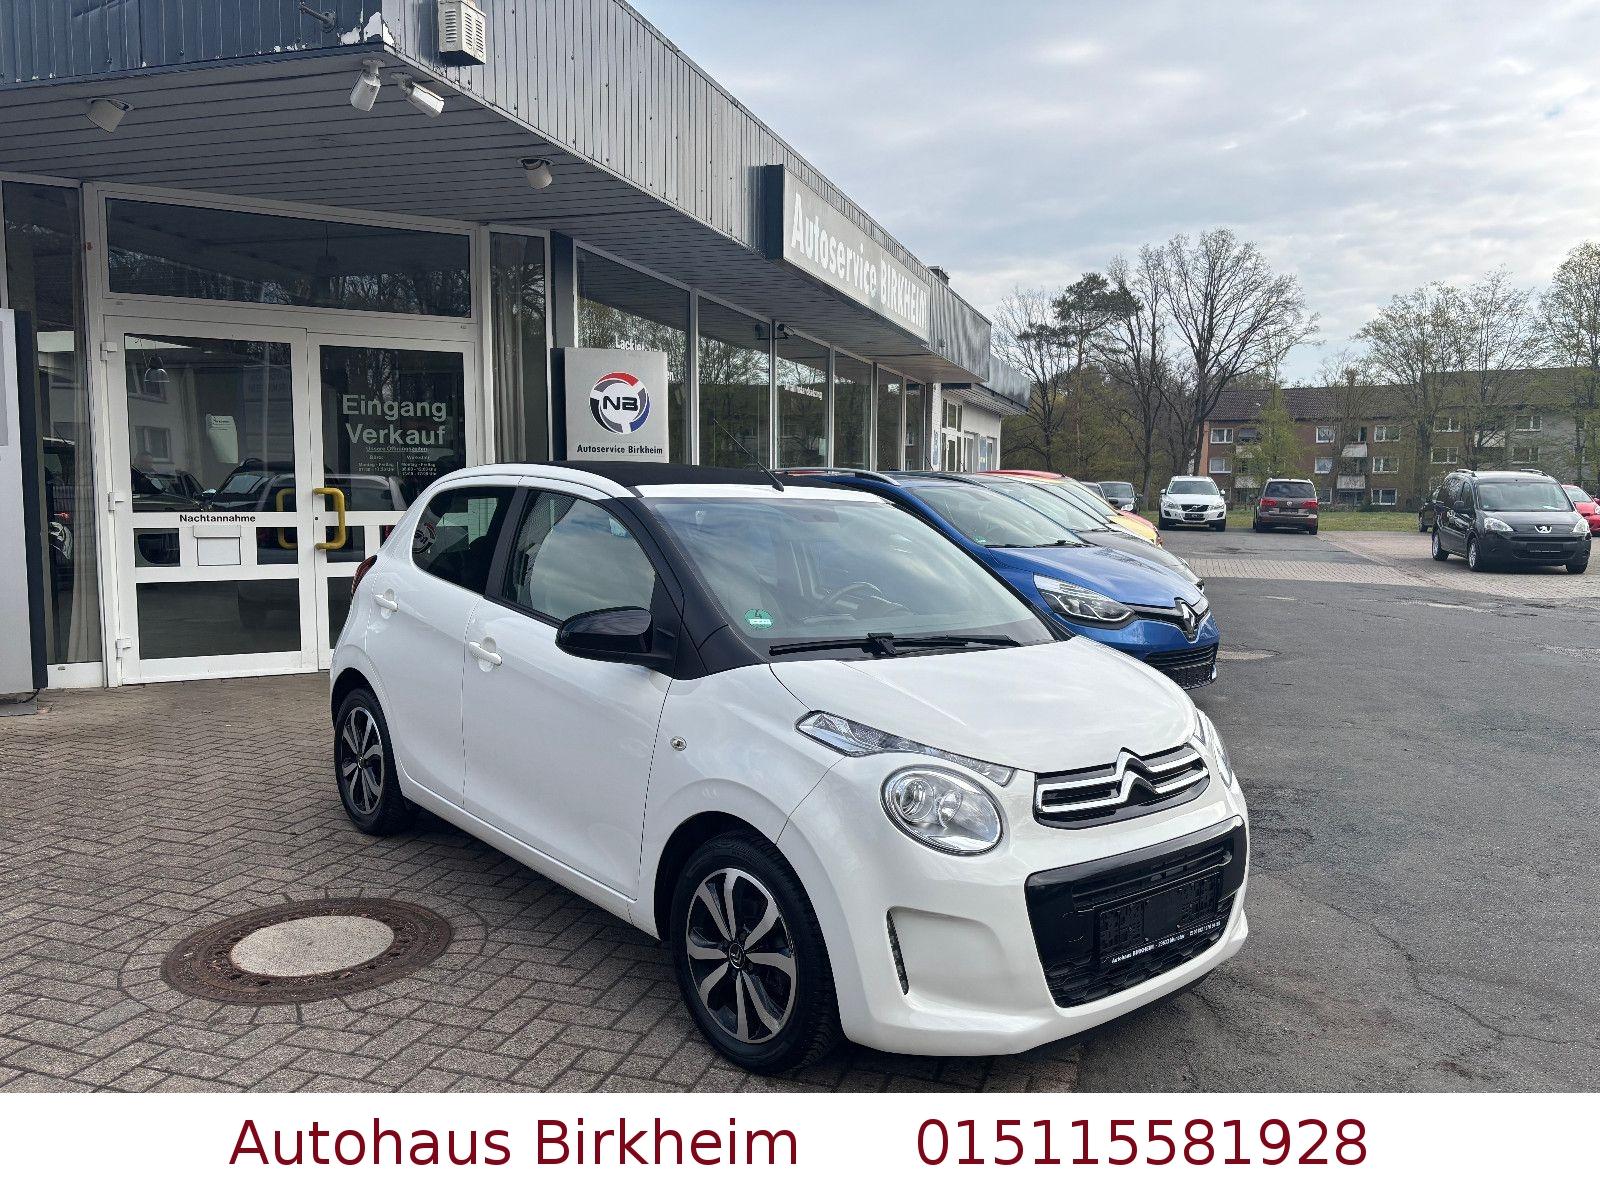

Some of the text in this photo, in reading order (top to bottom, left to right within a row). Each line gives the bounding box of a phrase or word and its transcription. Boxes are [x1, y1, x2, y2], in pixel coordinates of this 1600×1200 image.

[791, 192, 927, 331] Autoservice BIRKHEIM
[342, 394, 447, 422] Eingang
[602, 395, 639, 412] NB
[345, 423, 446, 445] Verkauf
[577, 444, 663, 455] Autoservice Birkheim
[179, 514, 256, 523] Nachtannahme
